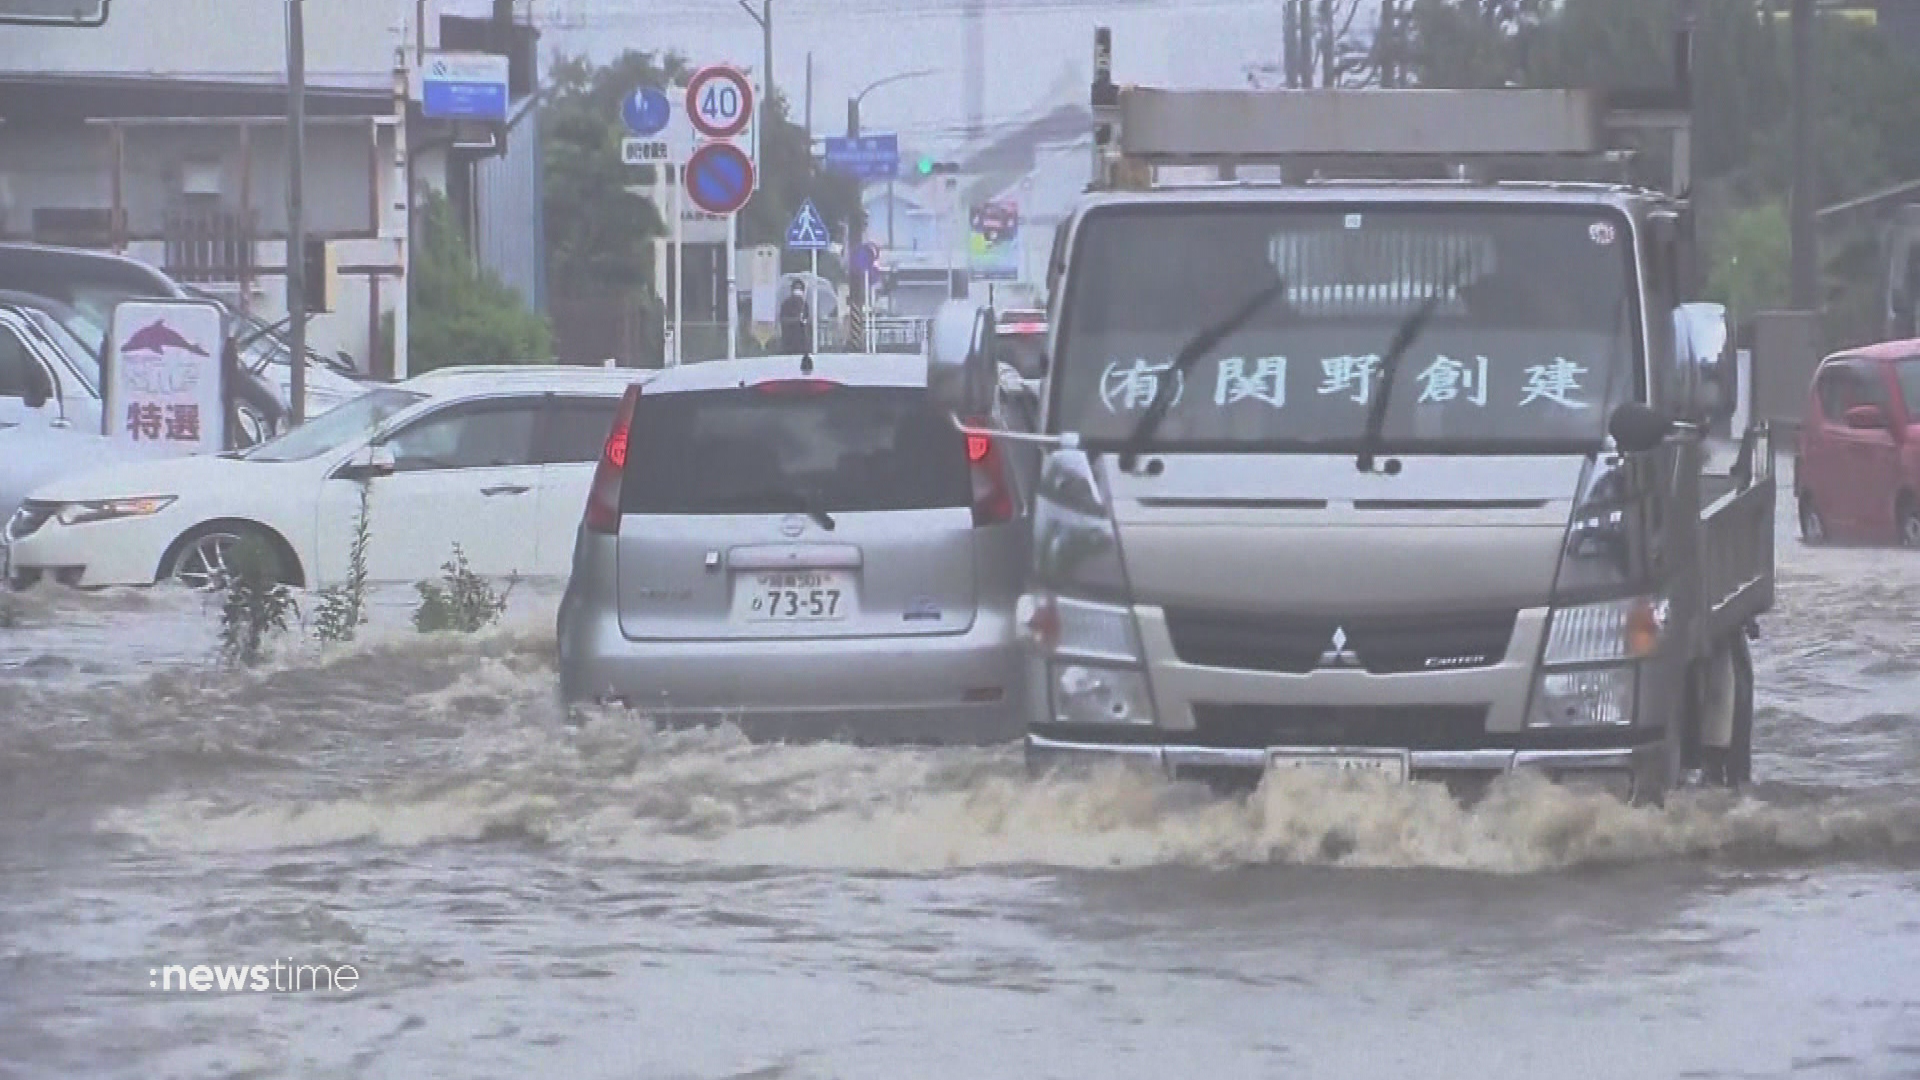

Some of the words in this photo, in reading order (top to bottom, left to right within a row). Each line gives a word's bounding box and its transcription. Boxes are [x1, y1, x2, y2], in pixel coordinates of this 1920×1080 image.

[702, 86, 737, 119] 40
[126, 402, 200, 441] 特選
[768, 590, 841, 616] 73-57
